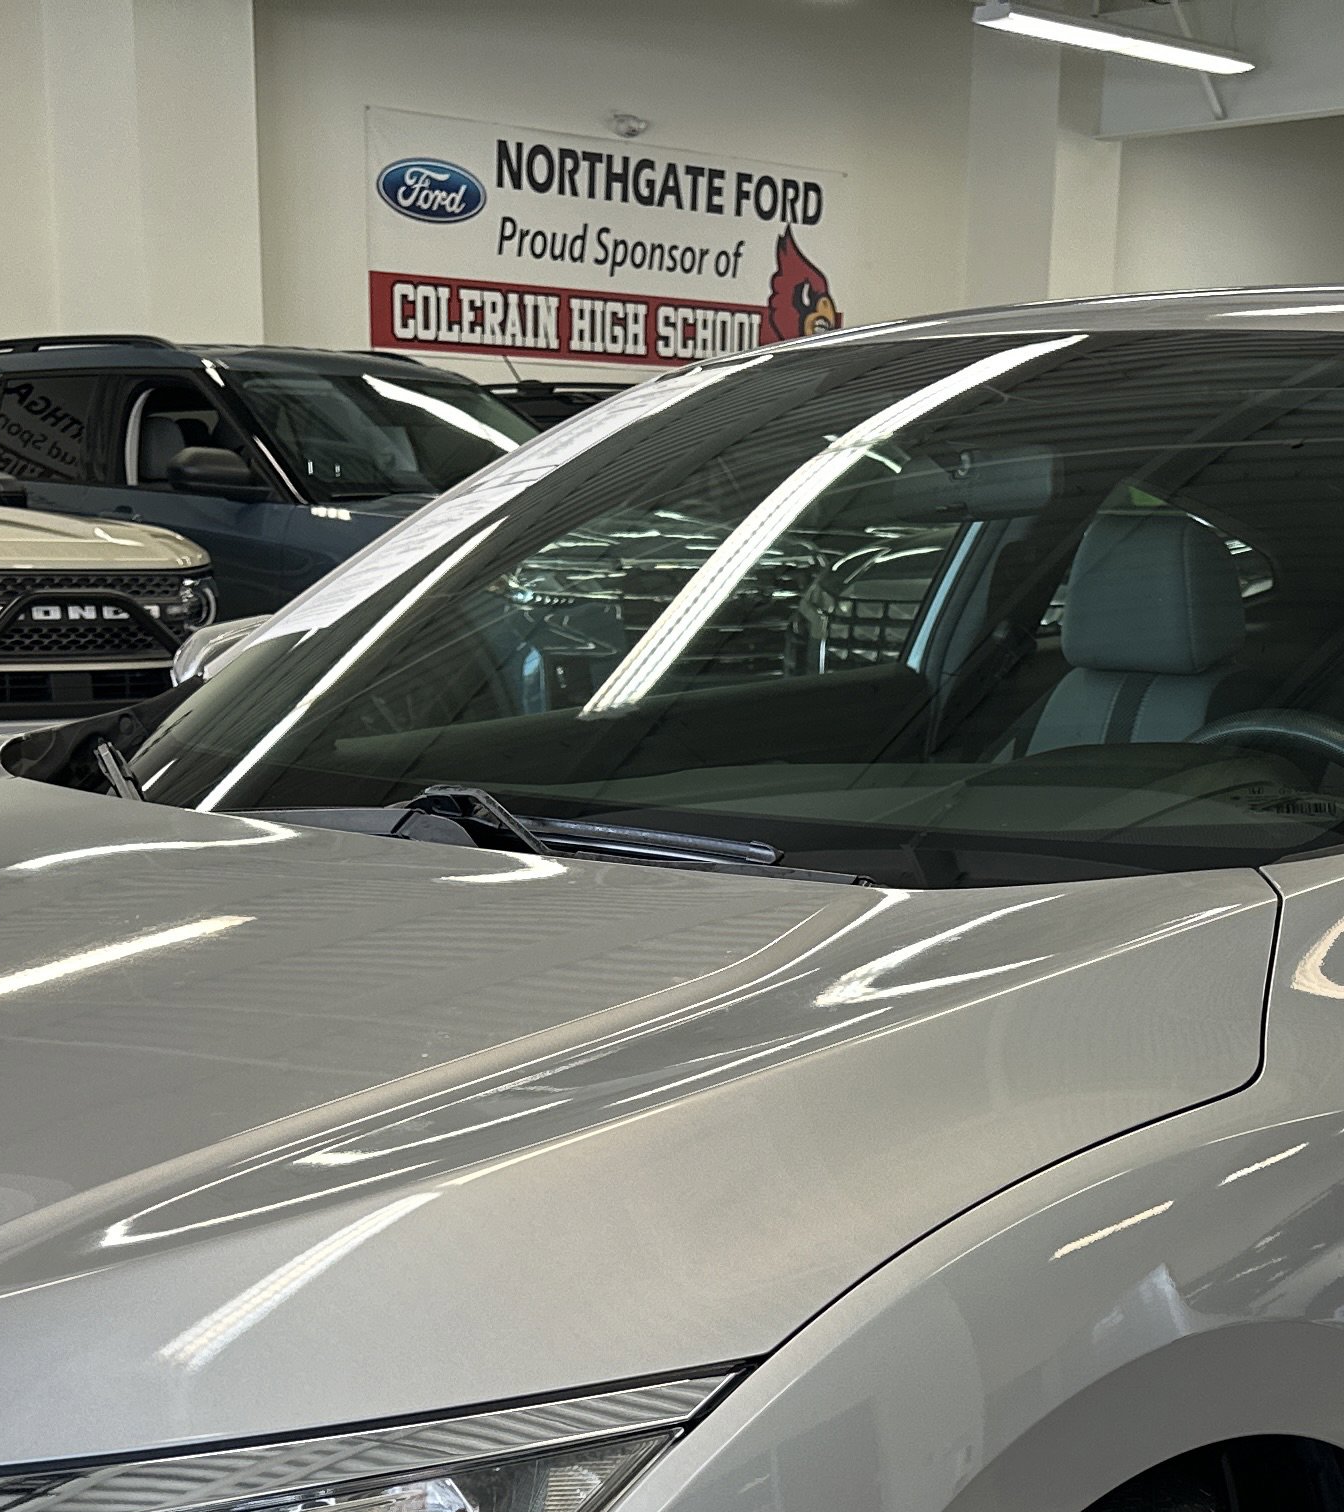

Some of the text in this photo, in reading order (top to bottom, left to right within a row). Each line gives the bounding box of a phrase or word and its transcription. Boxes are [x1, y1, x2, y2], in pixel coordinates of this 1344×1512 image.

[396, 166, 468, 216] Ford
[496, 138, 823, 226] NORTHGATE FORD
[497, 215, 746, 279] Proud Sponsor of
[391, 281, 761, 359] COLERAIN HIGH SCHOOL
